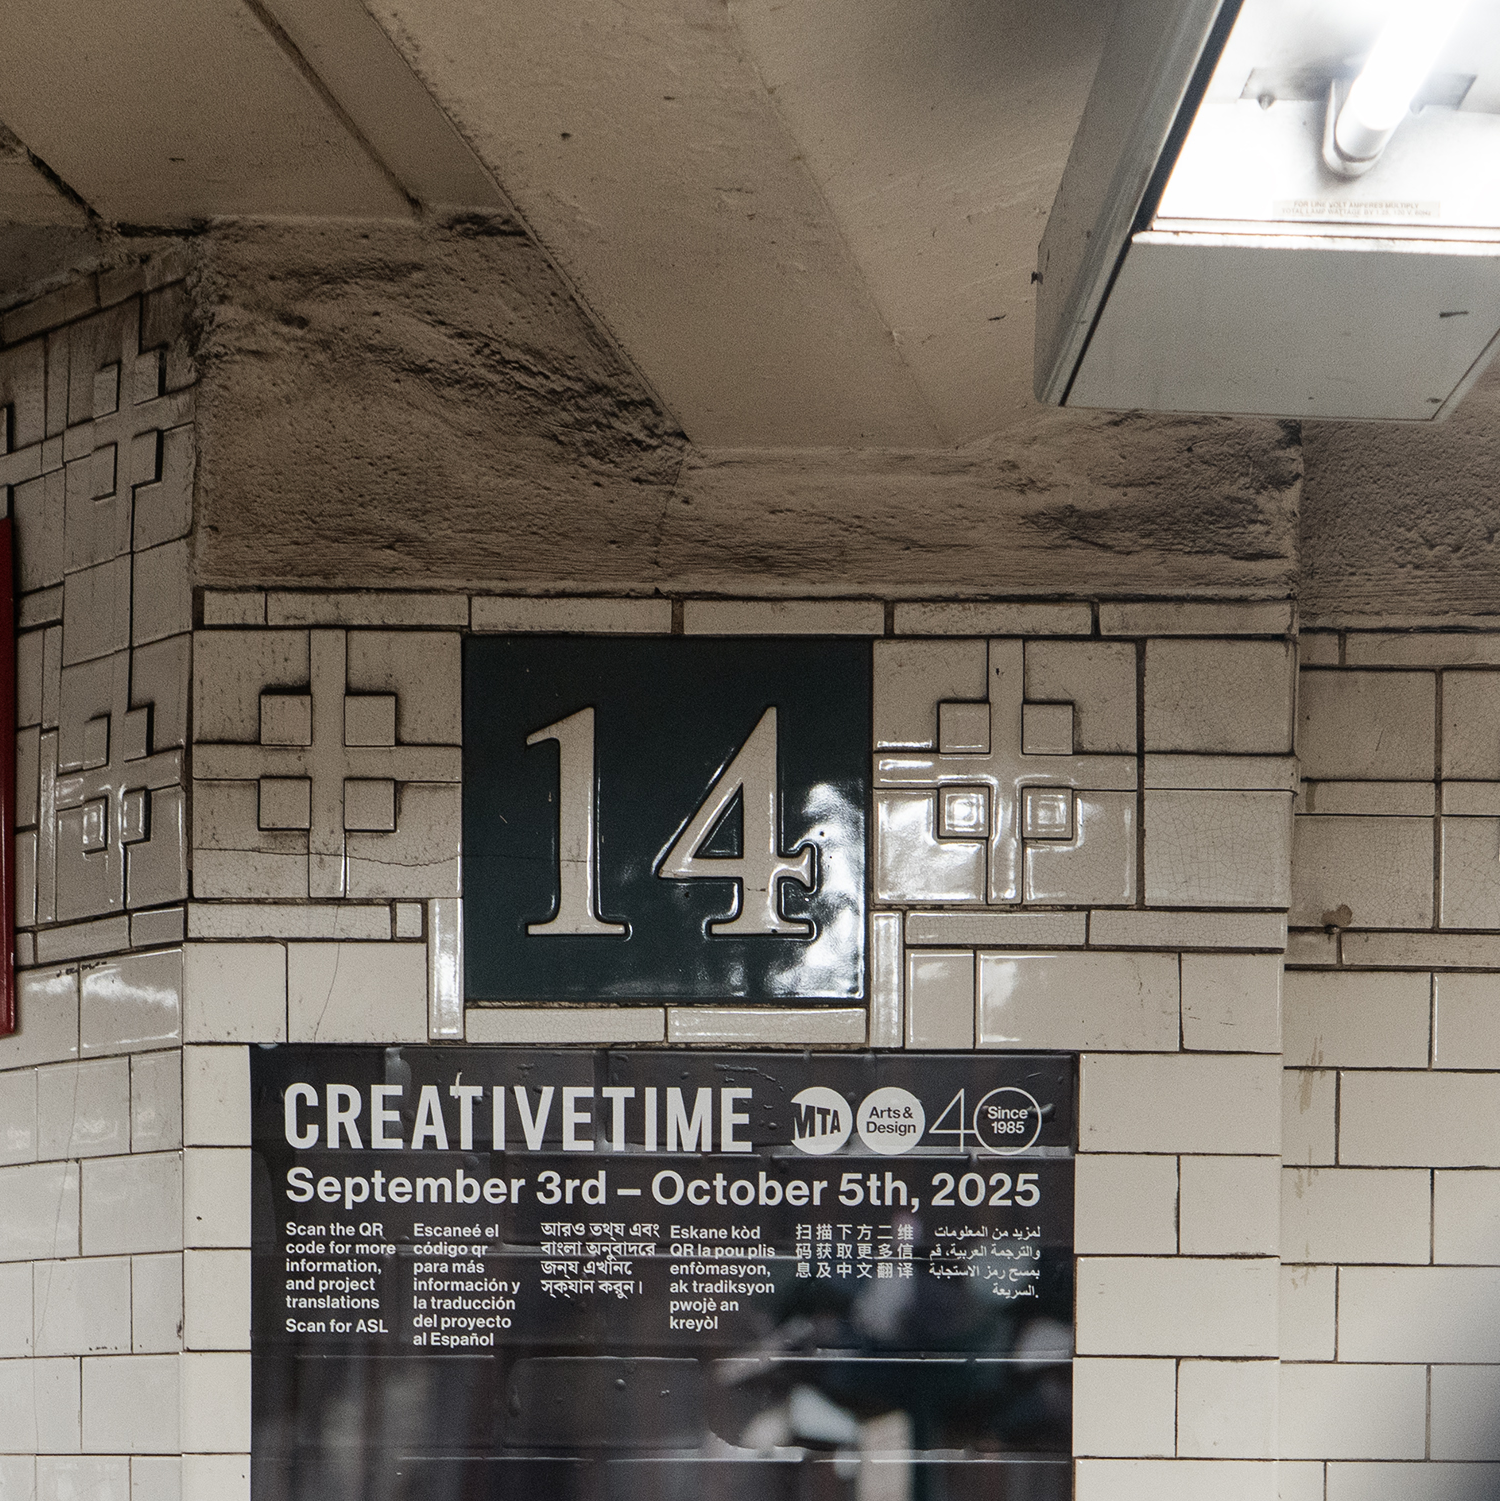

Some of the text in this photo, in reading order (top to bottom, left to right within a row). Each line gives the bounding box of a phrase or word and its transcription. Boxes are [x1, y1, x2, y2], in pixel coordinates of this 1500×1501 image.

[525, 704, 818, 936] 14
[284, 1082, 751, 1151] CREATIVETIME
[869, 1106, 913, 1118] Arts &
[987, 1106, 1028, 1119] Since
[793, 1103, 841, 1140] MTA
[866, 1121, 916, 1136] Design
[991, 1121, 1025, 1133] 1985
[285, 1167, 526, 1210] September
[536, 1170, 608, 1206] 3rd
[650, 1170, 829, 1206] October
[838, 1171, 921, 1212] 5th,
[931, 1174, 1040, 1208] 2025
[286, 1222, 383, 1237] Scan the QR
[414, 1223, 499, 1237] Escaneé el
[670, 1225, 760, 1239] Eskane kòd
[796, 1224, 914, 1241] 扫描下方二维
[934, 1226, 1041, 1240] لمزيد من المعلومات
[286, 1241, 396, 1254] code for more
[413, 1242, 488, 1258] código qr
[541, 1241, 582, 1256] বাংলা
[670, 1244, 776, 1261] QR la pou plis
[796, 1243, 914, 1260] 码获取更多信
[929, 1243, 942, 1260] قم
[991, 1243, 1041, 1260] والترجمة
[286, 1259, 382, 1274] information,
[413, 1260, 485, 1276] para más
[669, 1262, 771, 1278] enfòmasyon,
[796, 1262, 914, 1279] 息及中文翻译
[929, 1263, 1040, 1282] بمسح رمز الاستجابة
[286, 1277, 375, 1293] and project
[413, 1278, 520, 1294] información y
[670, 1280, 775, 1296] ak tradiksyon
[286, 1295, 379, 1309] translations
[413, 1296, 515, 1310] la traducción
[670, 1299, 739, 1314] pwojè an
[286, 1318, 388, 1332] Scan for ASL
[413, 1314, 511, 1331] del proyecto
[670, 1316, 718, 1332] kreyòl
[413, 1332, 494, 1348] al Español
